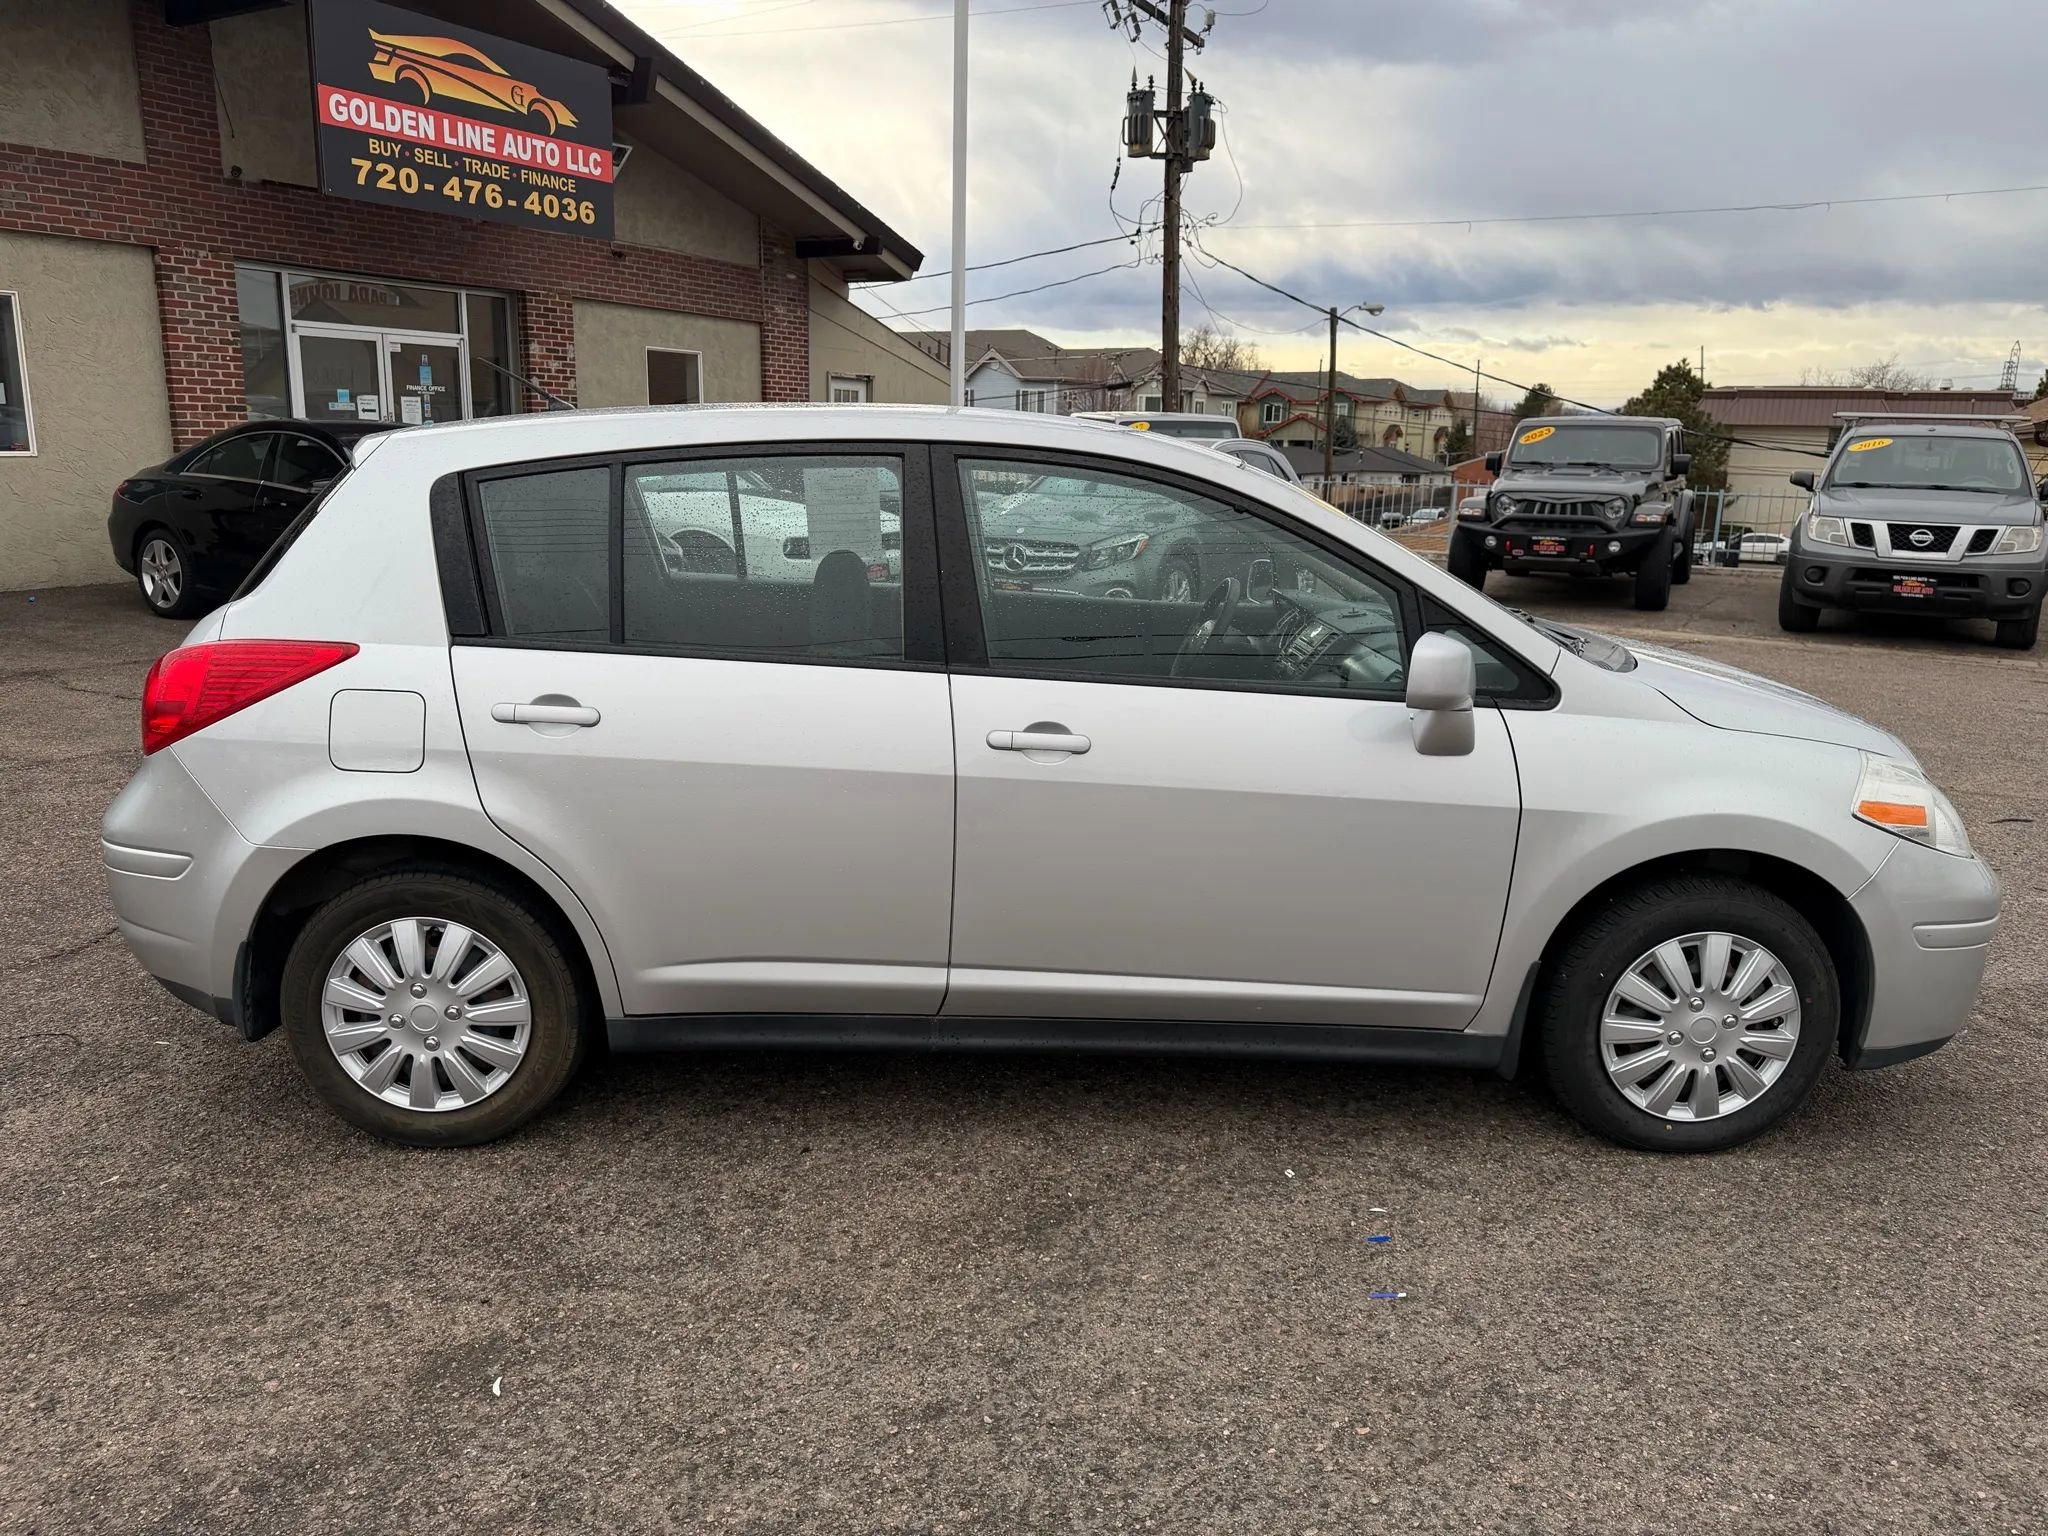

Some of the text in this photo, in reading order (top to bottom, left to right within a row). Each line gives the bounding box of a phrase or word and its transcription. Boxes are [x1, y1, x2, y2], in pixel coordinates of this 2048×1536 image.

[328, 92, 602, 177] GOLDEN LINE AUTO LLC
[368, 138, 577, 194] BUY SELL TRADE FINANCE
[406, 384, 427, 392] FINANCE
[1523, 428, 1552, 442] 2023
[1857, 440, 1885, 450] 2016
